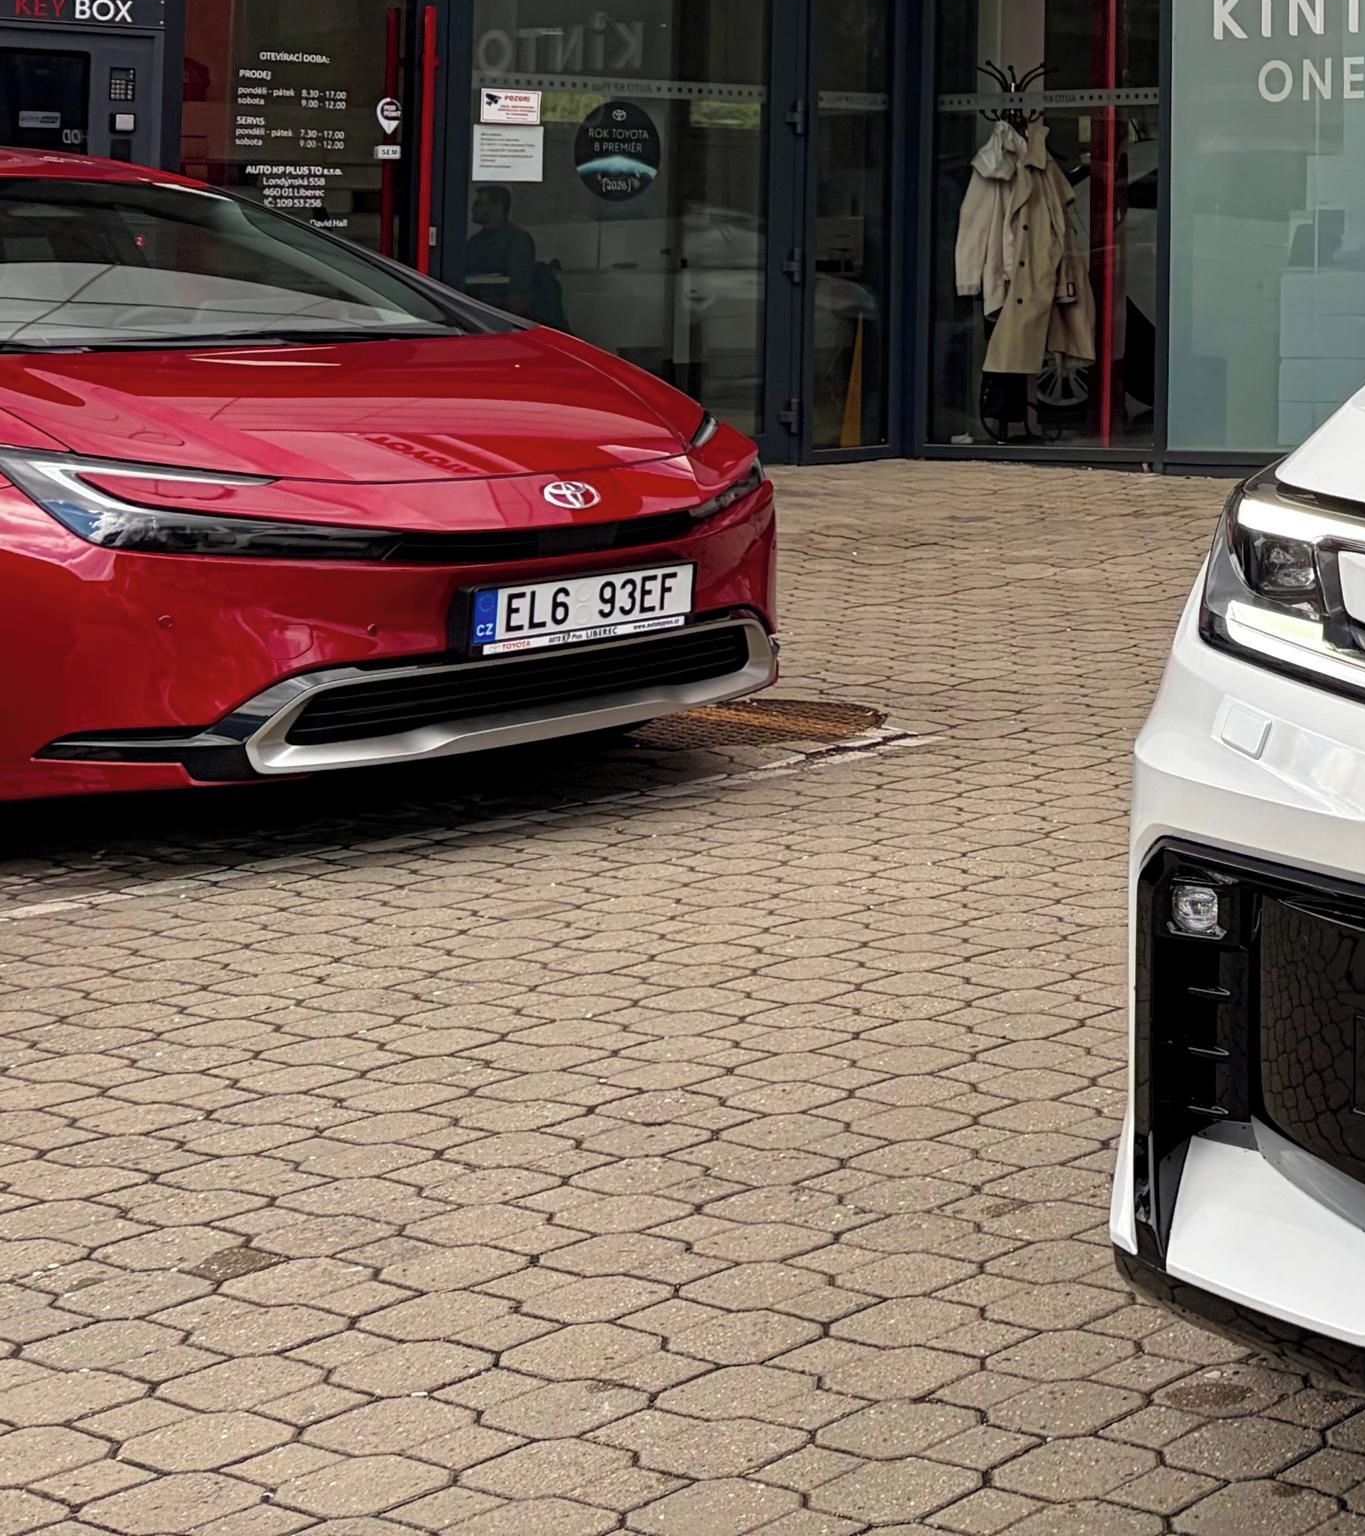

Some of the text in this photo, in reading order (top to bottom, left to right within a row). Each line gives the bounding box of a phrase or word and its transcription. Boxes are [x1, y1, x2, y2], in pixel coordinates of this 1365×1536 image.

[259, 50, 330, 64] OTEVÍRACÍ DOBA:
[239, 69, 272, 80] PRODEJ
[1258, 56, 1365, 103] ONE
[326, 91, 347, 100] 17.00
[237, 97, 265, 106] sobota
[301, 99, 319, 108] 9.00
[325, 100, 346, 109] 12.00
[236, 116, 265, 125] SERVIS
[300, 129, 317, 138] 7.30
[324, 131, 345, 139] 17.00
[588, 128, 649, 140] ROK TOYOTA
[235, 138, 263, 146] sobota
[323, 141, 344, 149] 12.00
[602, 141, 643, 153] PREMIÉR
[245, 165, 272, 175] AUTO
[272, 165, 285, 175] KP
[285, 166, 310, 175] PLUS
[310, 166, 322, 175] TO
[308, 177, 325, 186] 558
[263, 188, 325, 197] 460 01 Liberec
[275, 199, 293, 208] 109
[293, 199, 305, 208] 53
[305, 199, 322, 208] 256
[332, 219, 348, 227] Hall
[505, 571, 678, 633] EL6 93EF
[476, 623, 494, 637] CZ
[585, 627, 618, 639] LIBEREC
[502, 641, 531, 651] TOYOTA
